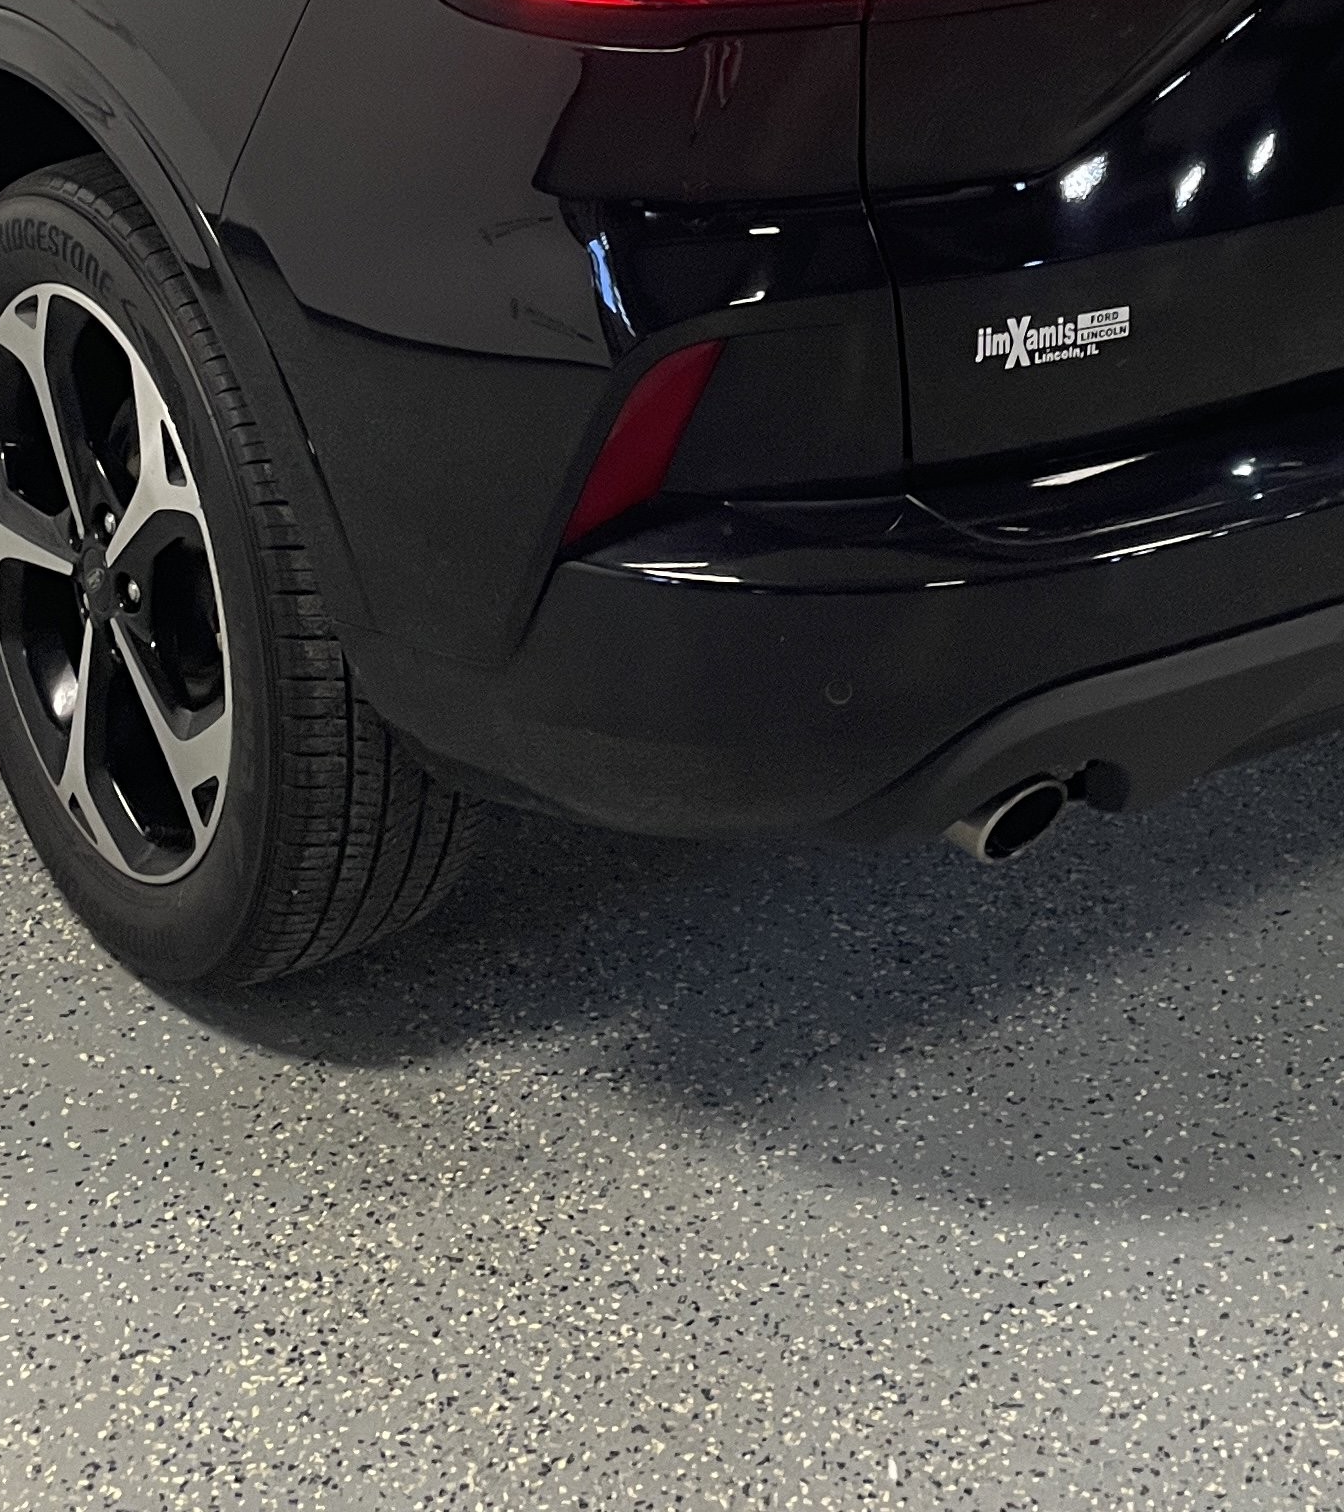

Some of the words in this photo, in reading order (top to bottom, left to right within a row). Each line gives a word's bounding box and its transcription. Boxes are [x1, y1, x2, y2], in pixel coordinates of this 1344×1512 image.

[1089, 310, 1120, 325] FORD
[1079, 324, 1128, 343] LINCOLN
[1034, 345, 1085, 365] Lincoln,
[1086, 343, 1100, 356] IL
